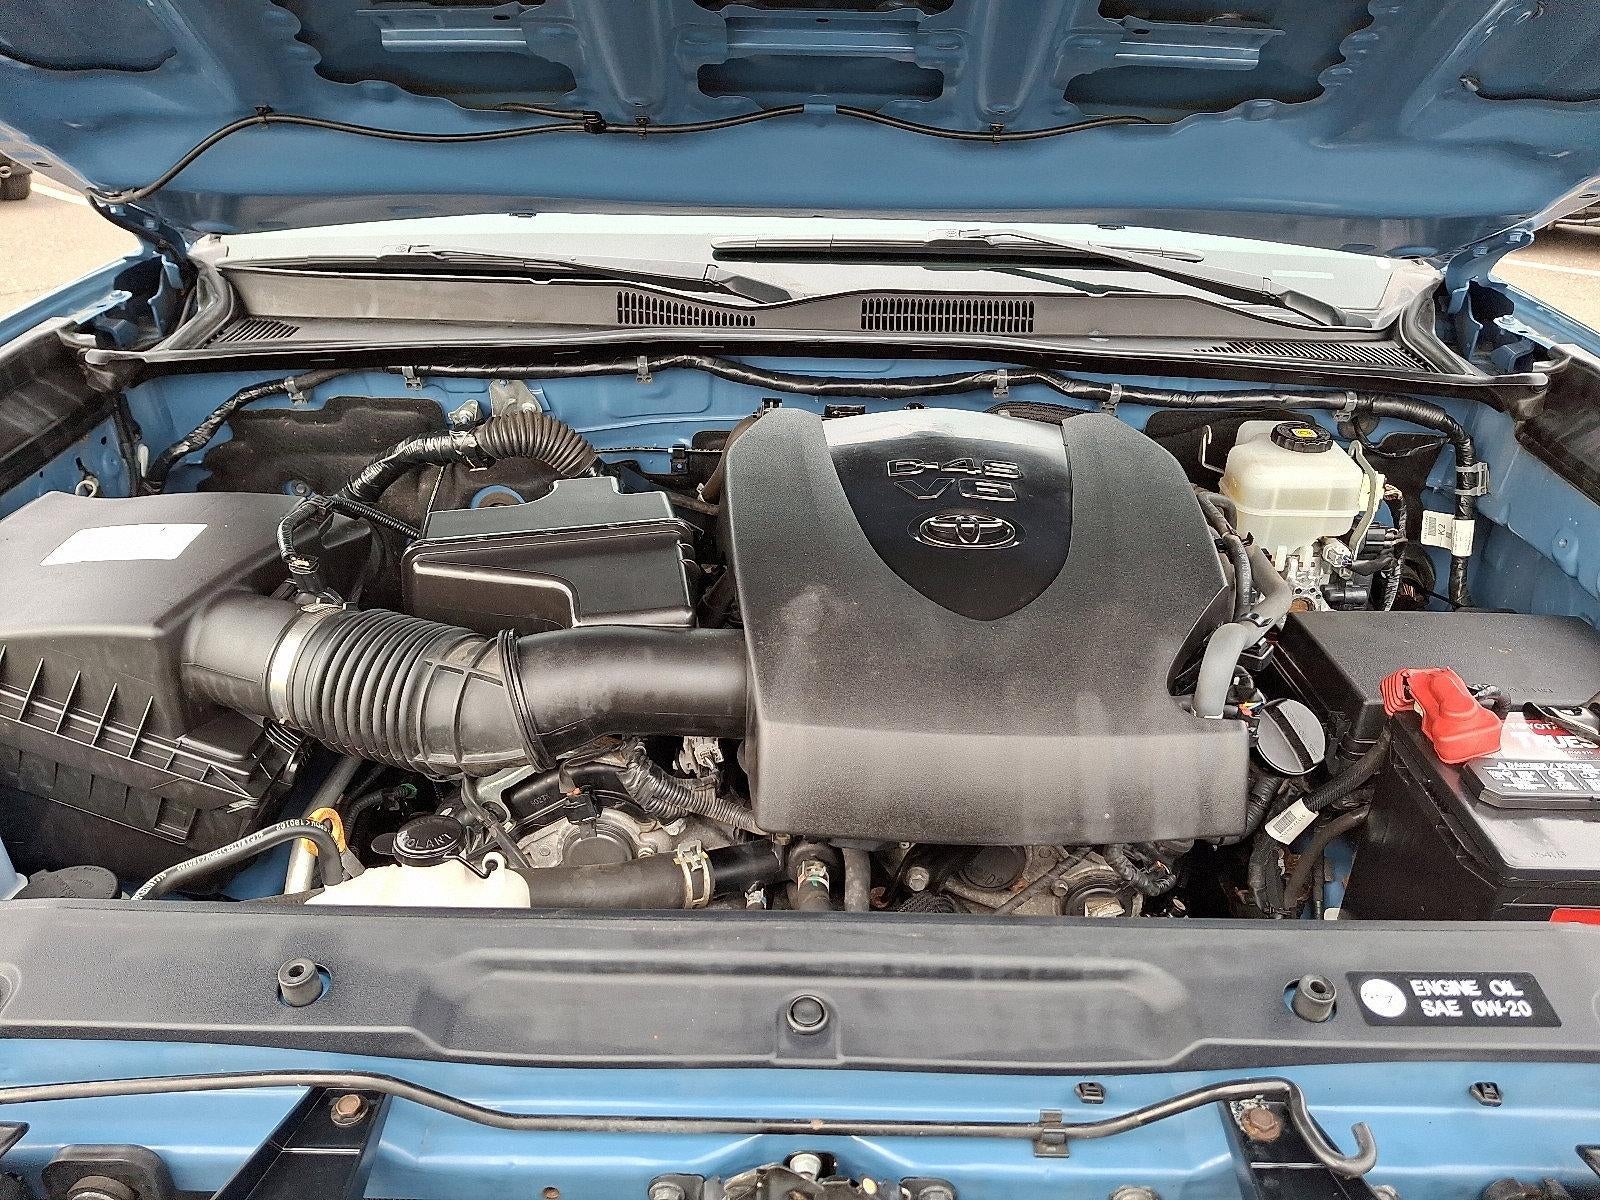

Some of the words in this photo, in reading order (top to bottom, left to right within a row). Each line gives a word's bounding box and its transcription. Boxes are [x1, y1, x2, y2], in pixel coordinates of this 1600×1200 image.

[887, 457, 1023, 480] D-4S
[893, 477, 1018, 501] V6
[1409, 979, 1482, 997] ENGINE
[1488, 979, 1524, 997] OIL
[1420, 1000, 1464, 1018] SAE
